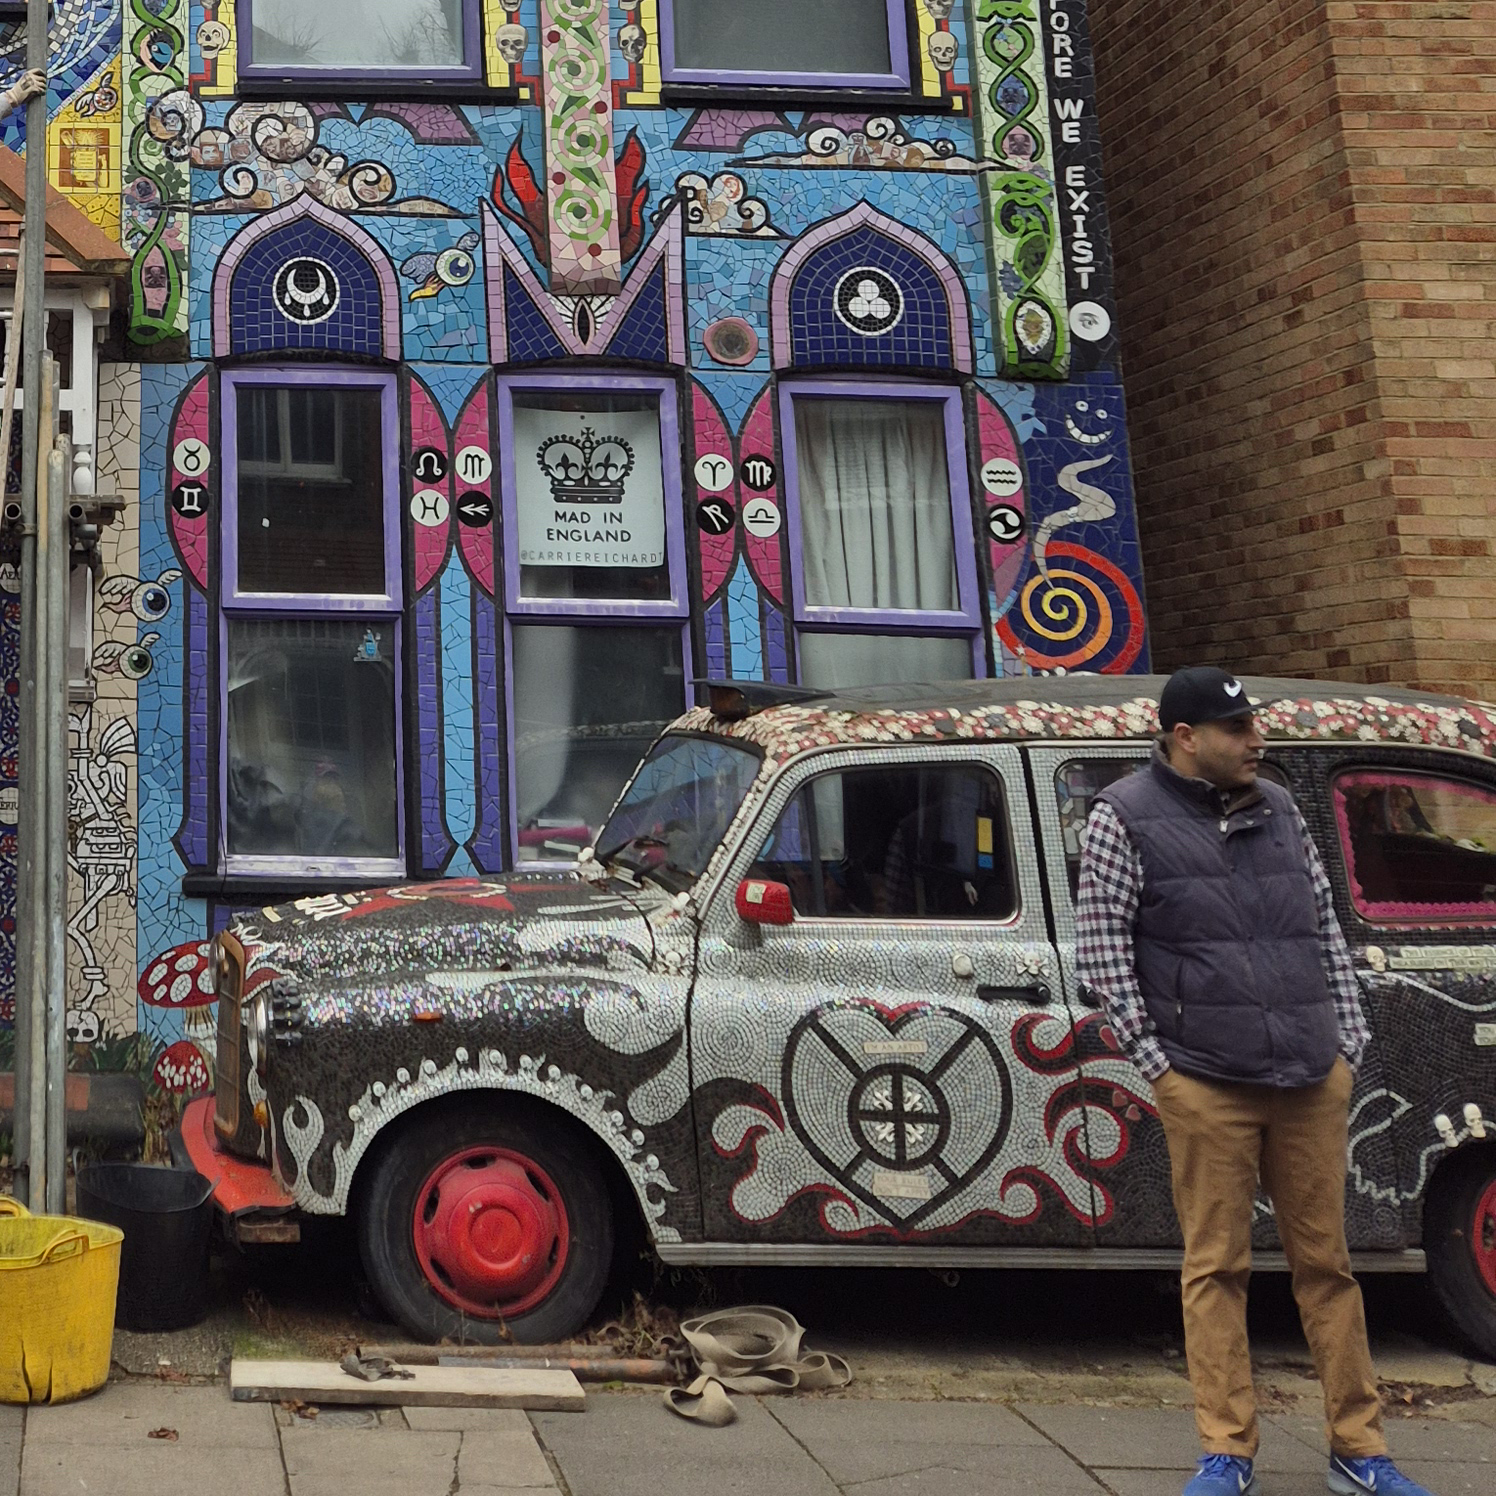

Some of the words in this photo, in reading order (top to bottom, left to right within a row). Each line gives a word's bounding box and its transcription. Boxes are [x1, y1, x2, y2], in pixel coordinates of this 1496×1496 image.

[1054, 98, 1084, 144] WE
[1065, 165, 1095, 291] EXIST
[554, 510, 592, 524] MAD
[604, 511, 623, 524] IN
[546, 528, 632, 543] ENGLAND
[521, 550, 663, 564] @CARRIEREICHARDT
